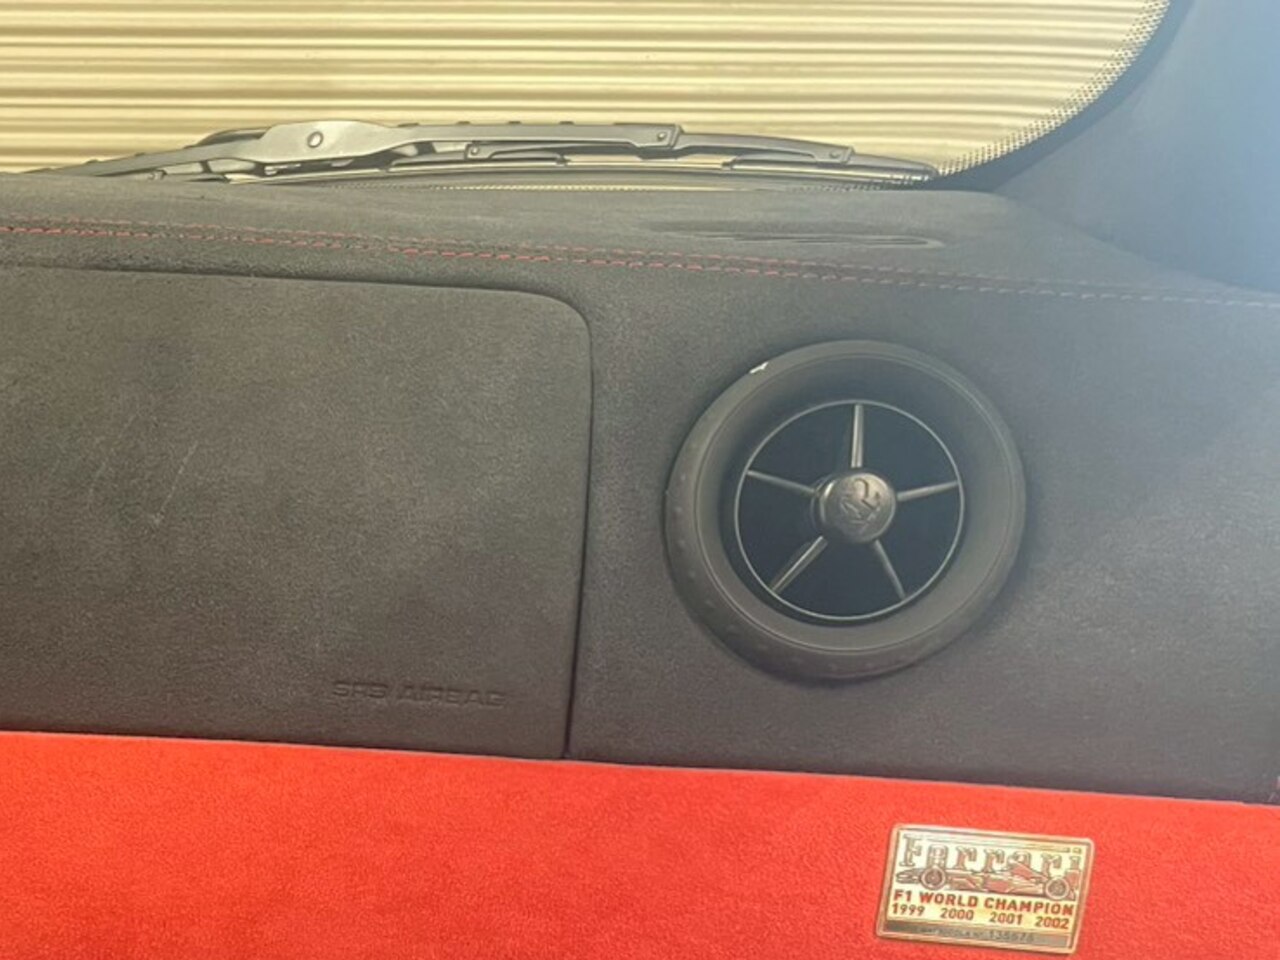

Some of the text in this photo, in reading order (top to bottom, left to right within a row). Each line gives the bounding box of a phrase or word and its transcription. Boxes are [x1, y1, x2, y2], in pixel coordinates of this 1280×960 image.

[396, 684, 507, 707] AIRBAG
[892, 903, 1070, 930] 1999 2000 2001 2002
[893, 889, 1074, 917] F1 WORLD CHAMPION
